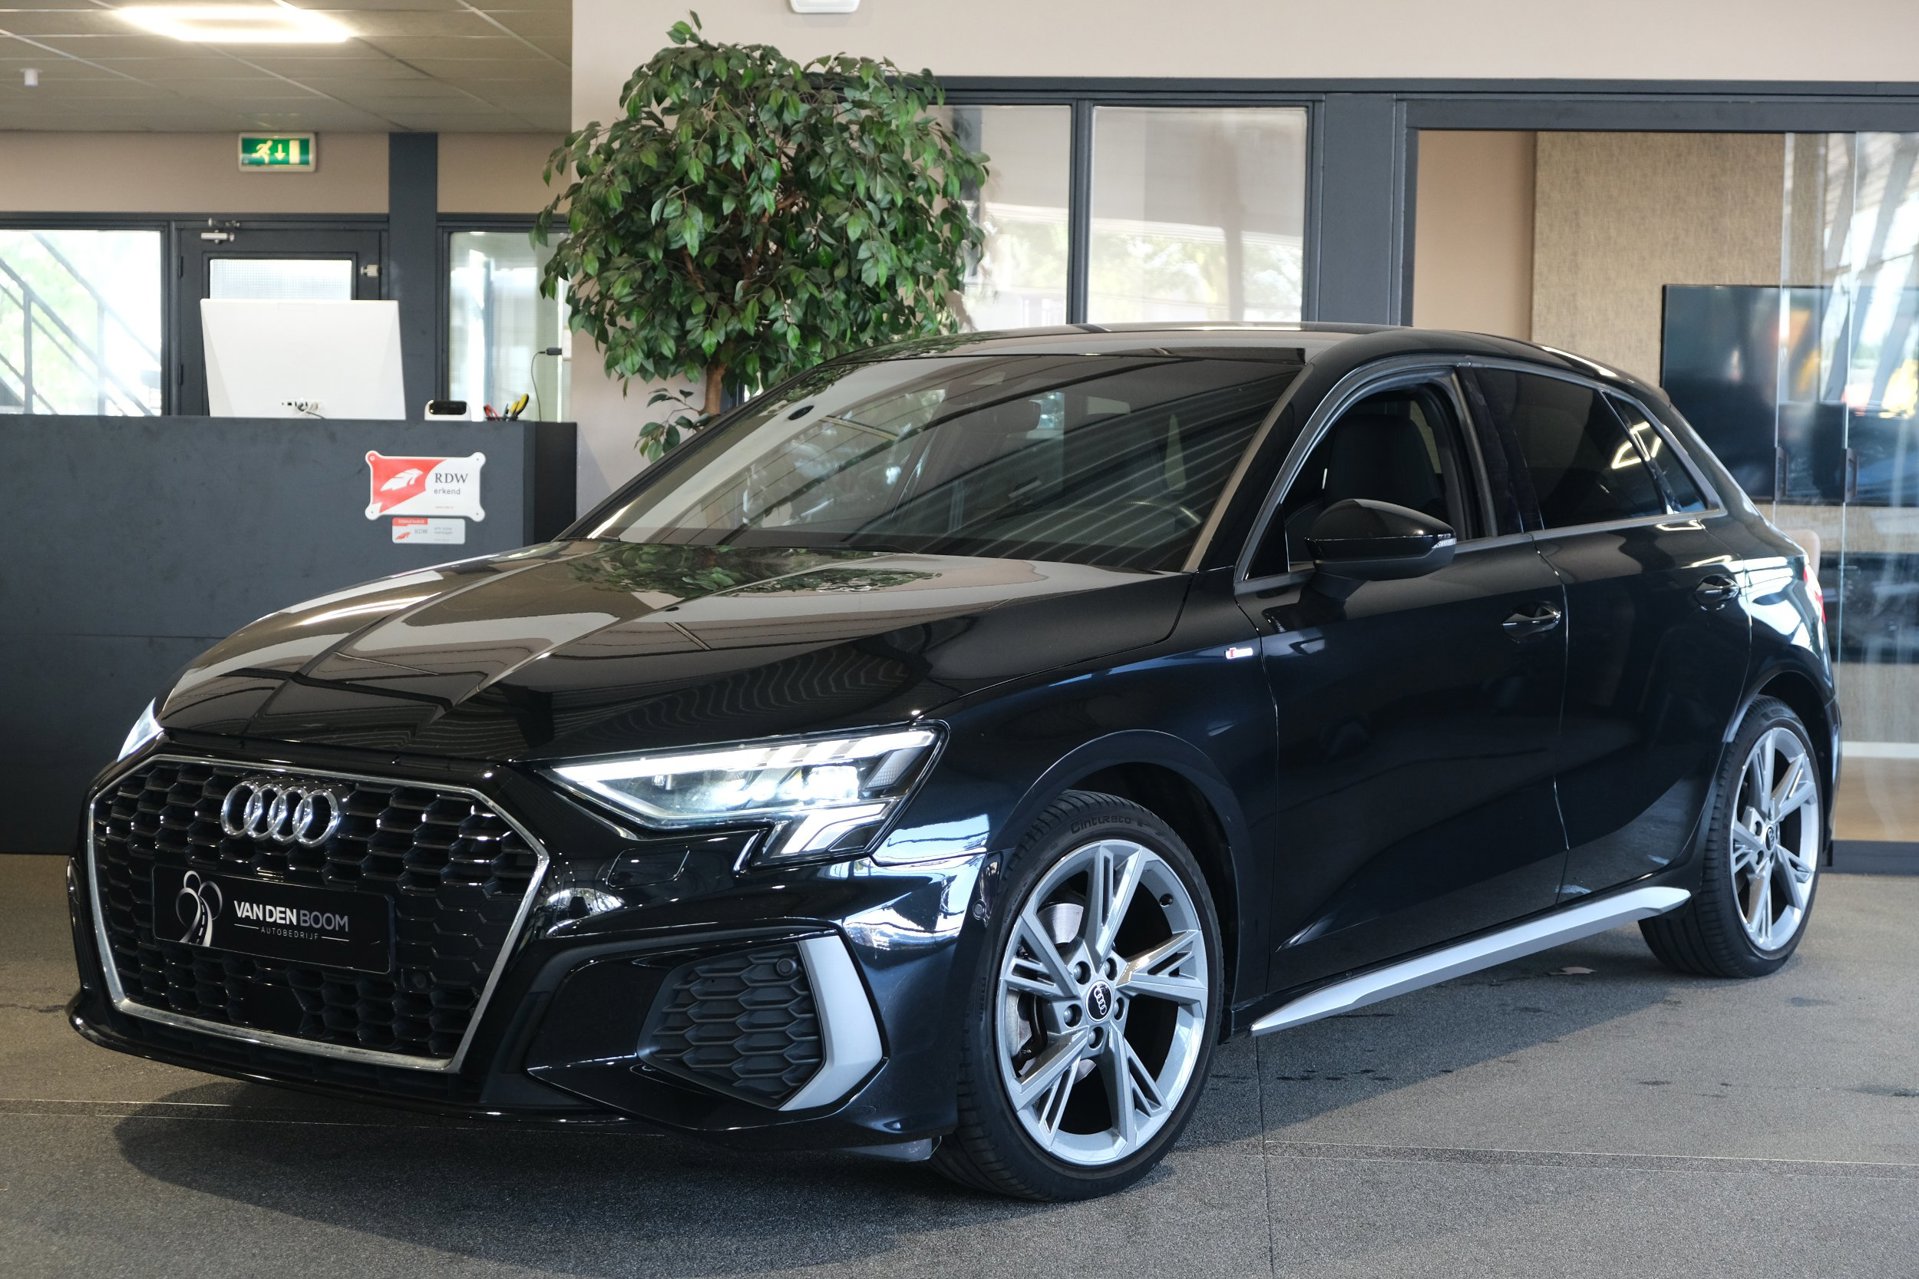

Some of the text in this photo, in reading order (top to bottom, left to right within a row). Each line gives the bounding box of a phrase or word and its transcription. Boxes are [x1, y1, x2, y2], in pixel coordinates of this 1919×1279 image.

[435, 472, 468, 484] RDW
[434, 488, 461, 496] erkend
[234, 900, 348, 932] VAN DEN BOOM
[260, 926, 319, 940] AUTOBEDRIJF
